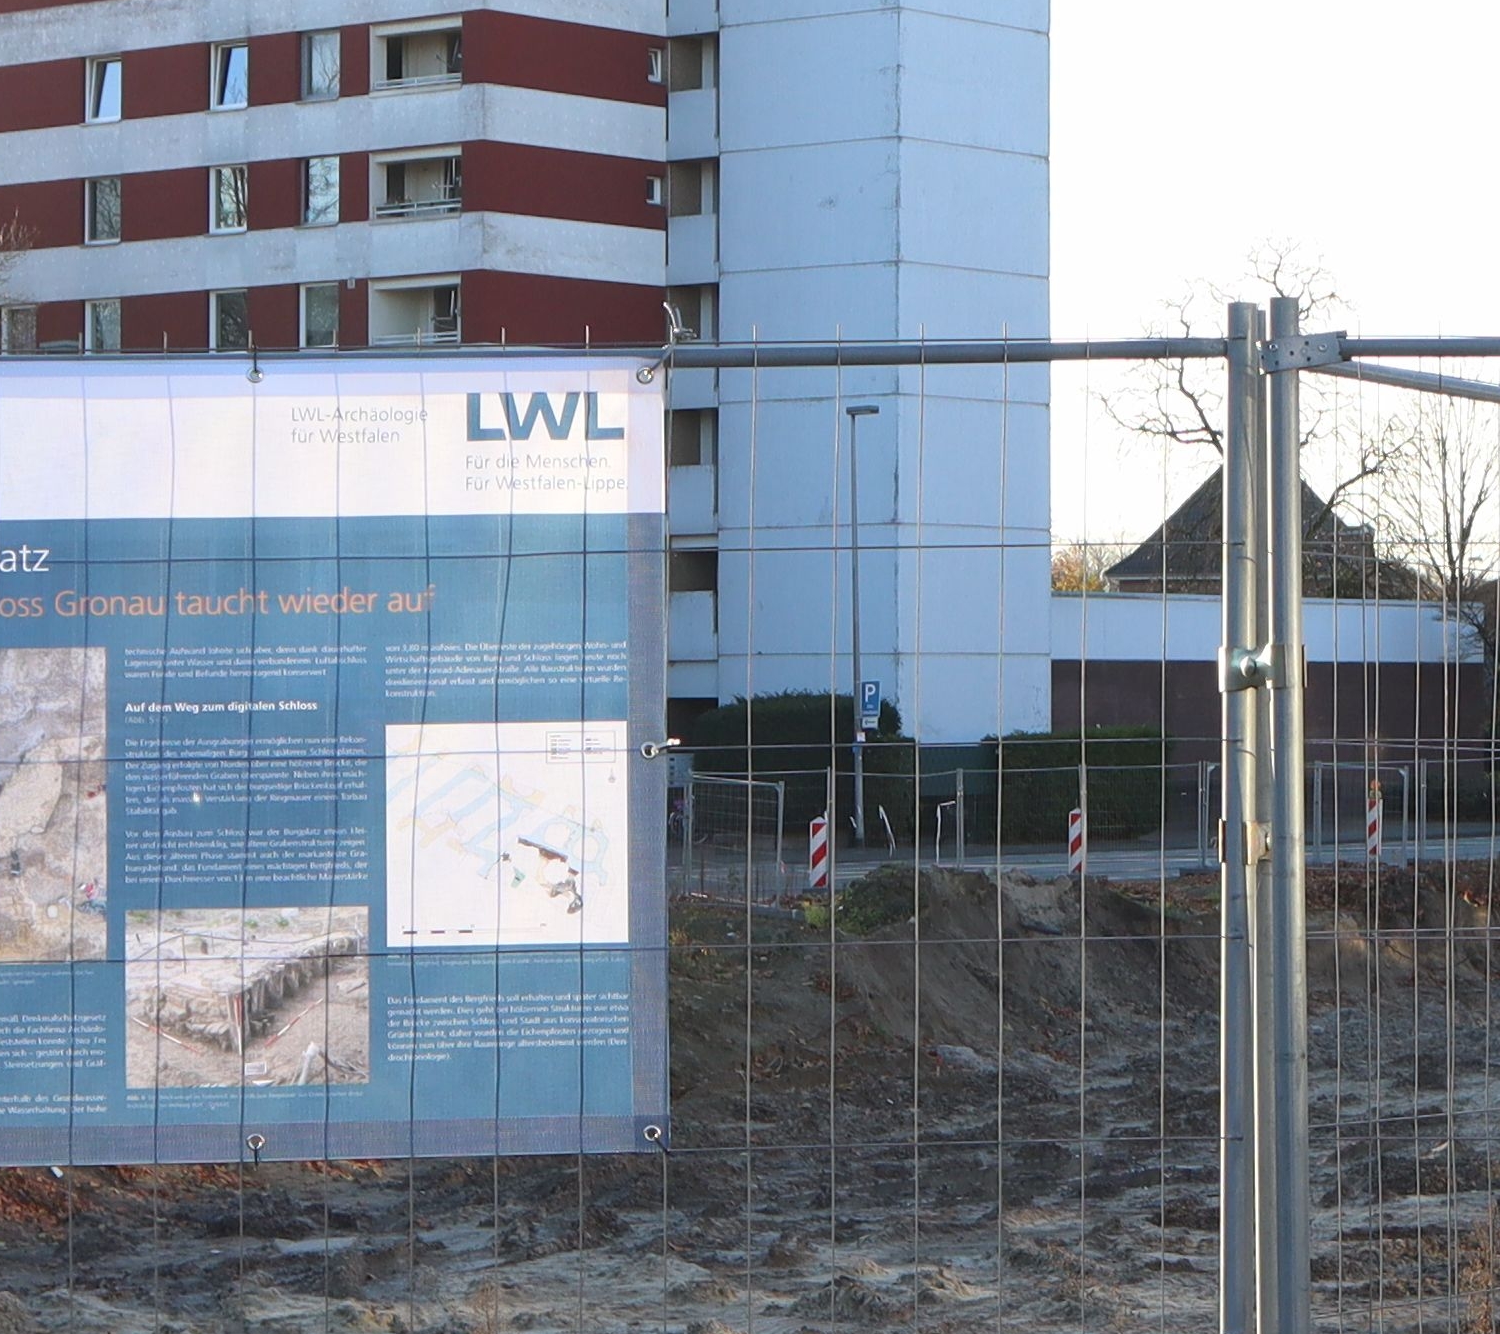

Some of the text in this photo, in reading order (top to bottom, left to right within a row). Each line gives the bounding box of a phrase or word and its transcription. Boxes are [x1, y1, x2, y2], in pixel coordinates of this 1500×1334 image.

[292, 407, 428, 425] LWL-Archäologie
[466, 391, 625, 441] LWL
[291, 428, 400, 443] für Westfalen
[465, 454, 610, 469] Für die Menschen.
[465, 476, 628, 493] Für Westfalen-Lippe.
[54, 590, 164, 616] Gronau
[176, 587, 269, 615] taucht
[279, 587, 377, 614] wieder
[387, 585, 436, 613] auf
[178, 669, 193, 677] und
[865, 684, 876, 702] P
[125, 703, 145, 712] Auf
[148, 703, 172, 712] dem
[175, 703, 199, 713] Weg
[228, 702, 275, 712] digitalen
[278, 702, 317, 711] Schloss
